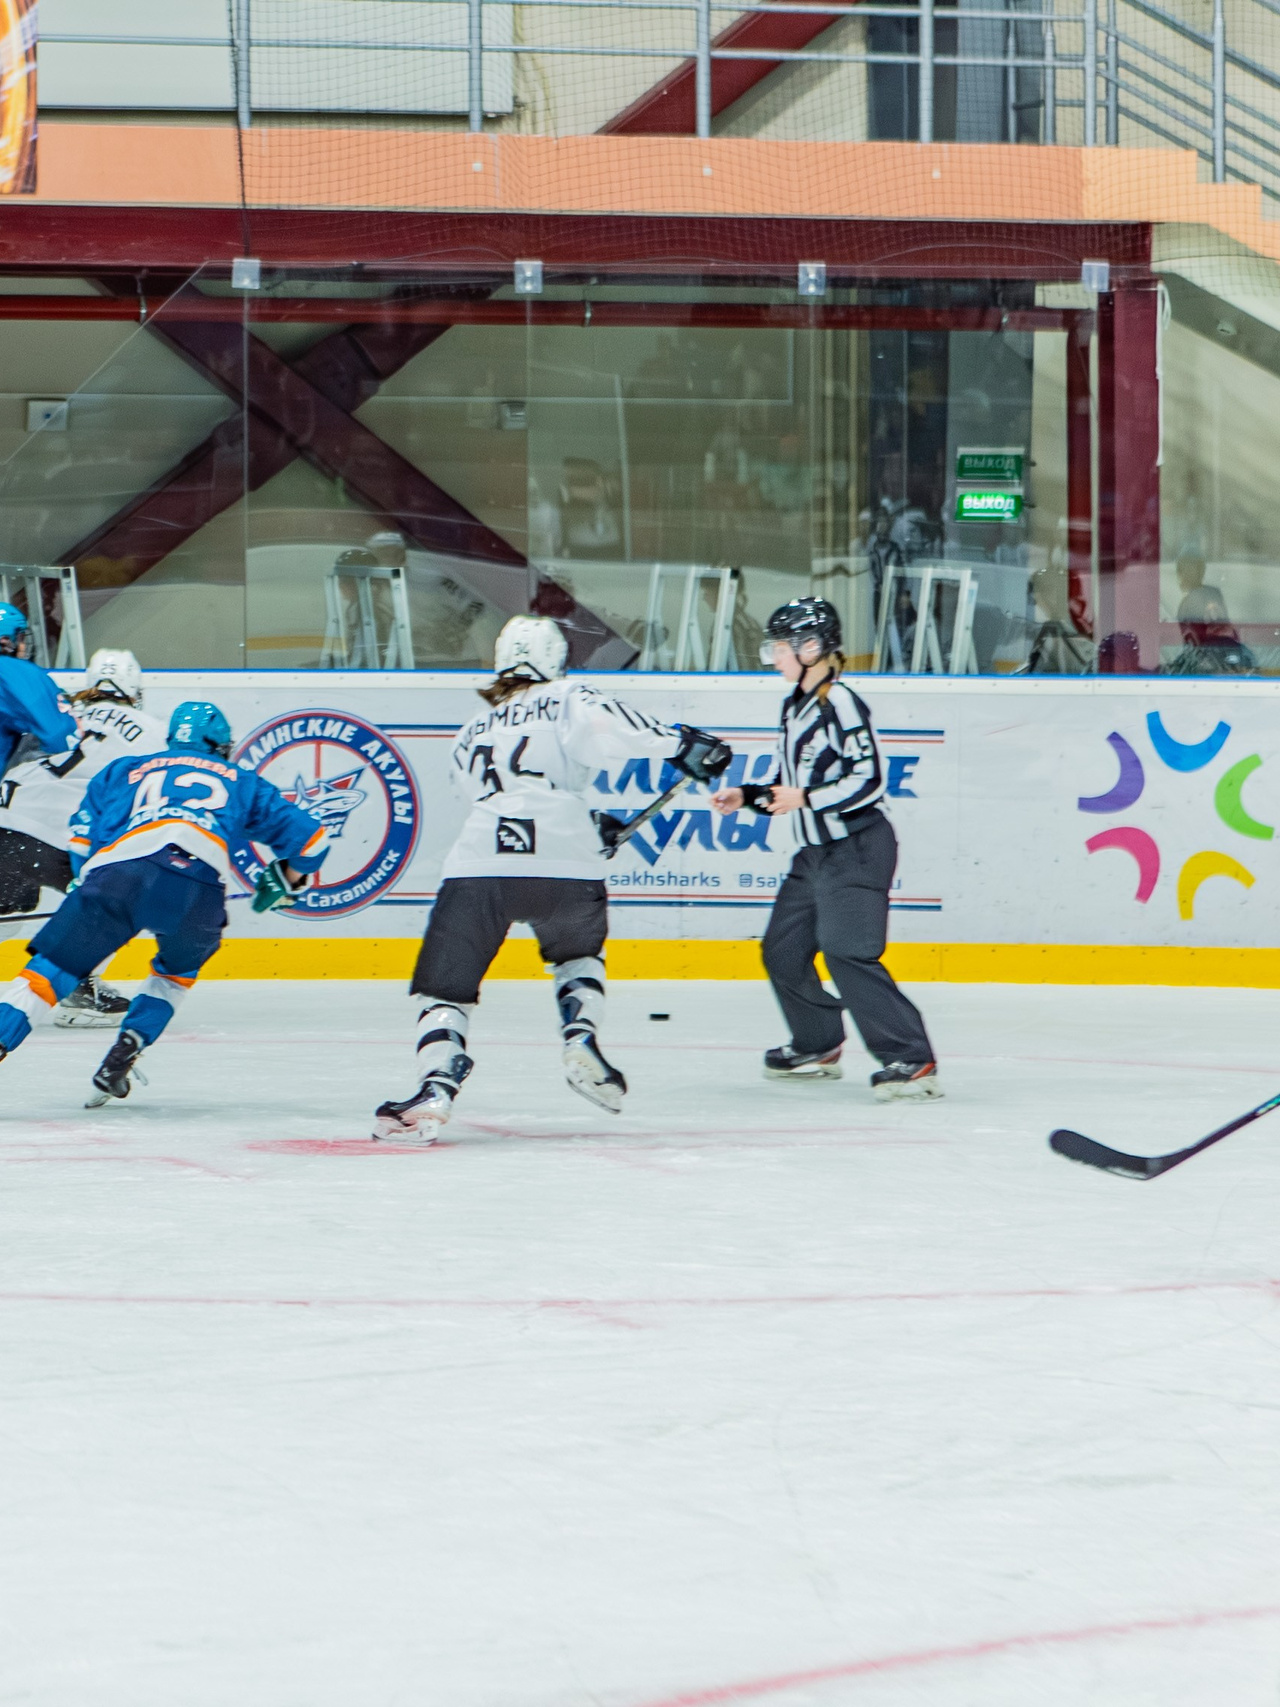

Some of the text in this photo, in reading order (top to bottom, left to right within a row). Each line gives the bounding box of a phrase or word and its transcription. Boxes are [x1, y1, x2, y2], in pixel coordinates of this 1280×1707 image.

[962, 494, 1016, 511] ВЫХОД
[360, 739, 413, 825] АКУЛЫ
[609, 871, 720, 888] sakhsharks
